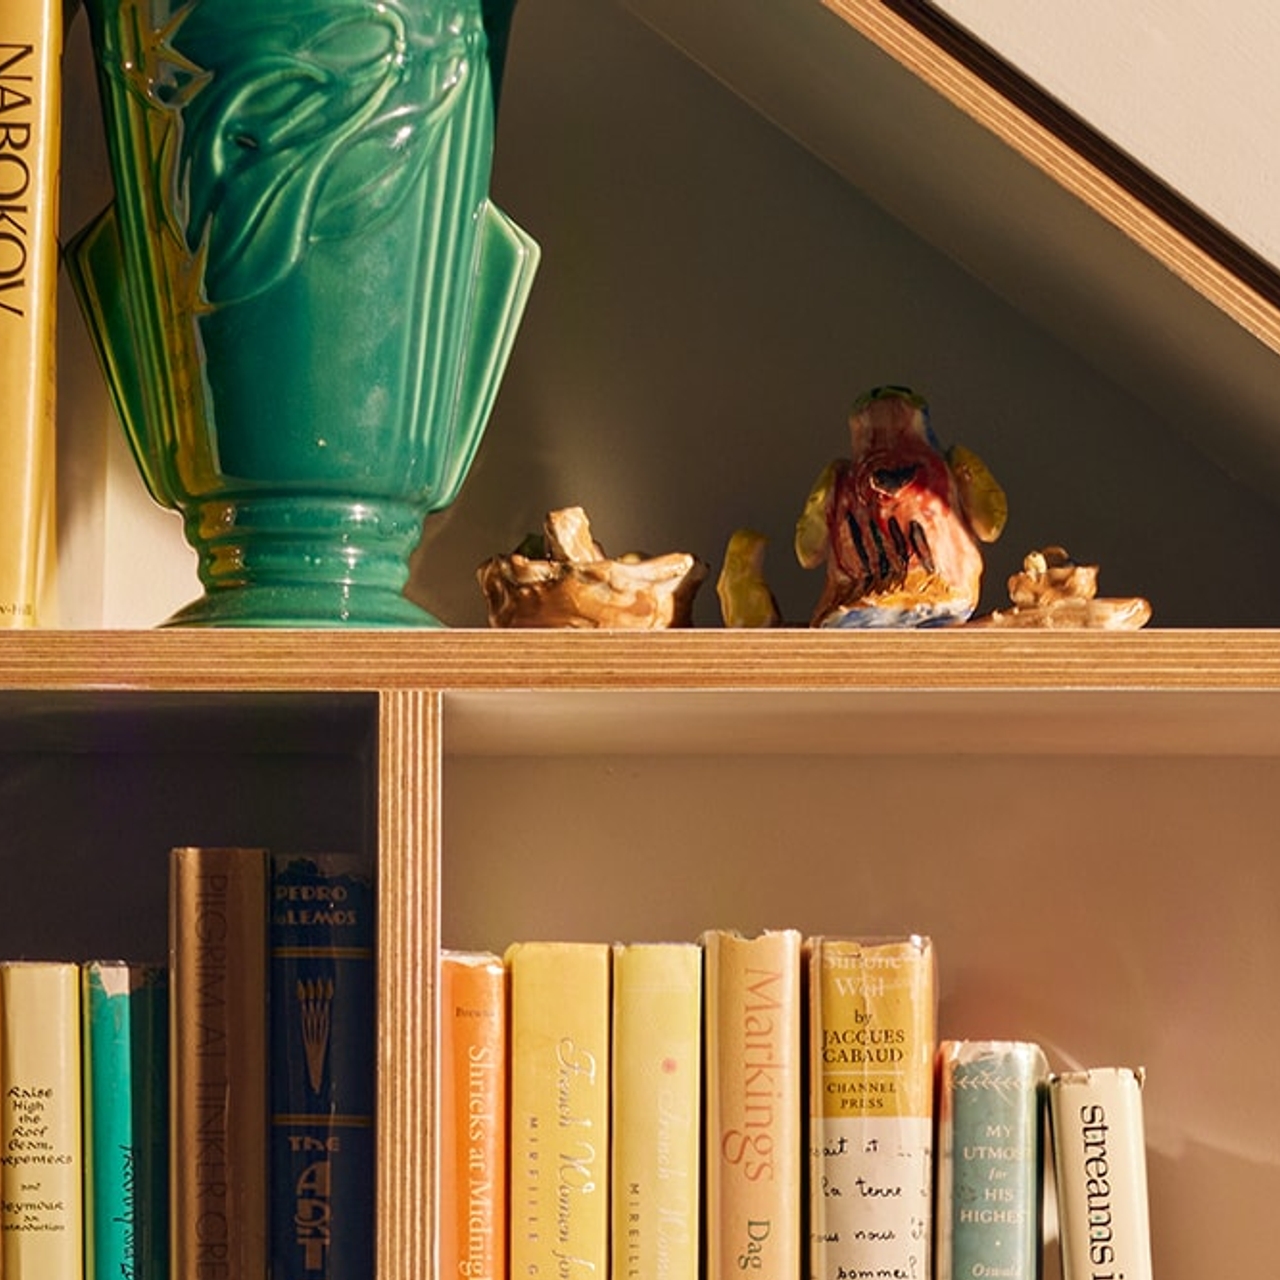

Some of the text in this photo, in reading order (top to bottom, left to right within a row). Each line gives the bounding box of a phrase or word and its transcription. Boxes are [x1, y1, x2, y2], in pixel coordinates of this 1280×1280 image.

[274, 885, 347, 901] PEDRO
[835, 977, 885, 997] Weil
[854, 1009, 873, 1025] by
[822, 1030, 905, 1050] JACQUES
[823, 1049, 904, 1064] CABAUD
[721, 967, 782, 1182] Markings
[468, 1045, 497, 1141] Shrieks
[827, 1082, 897, 1095] CHANNEL
[841, 1101, 884, 1110] PRESS
[985, 1126, 1011, 1138] MY
[289, 1136, 341, 1151] THE
[469, 1148, 494, 1179] at
[1080, 1105, 1114, 1266] streams
[984, 1188, 1015, 1202] HIS
[738, 1220, 771, 1271] Dag
